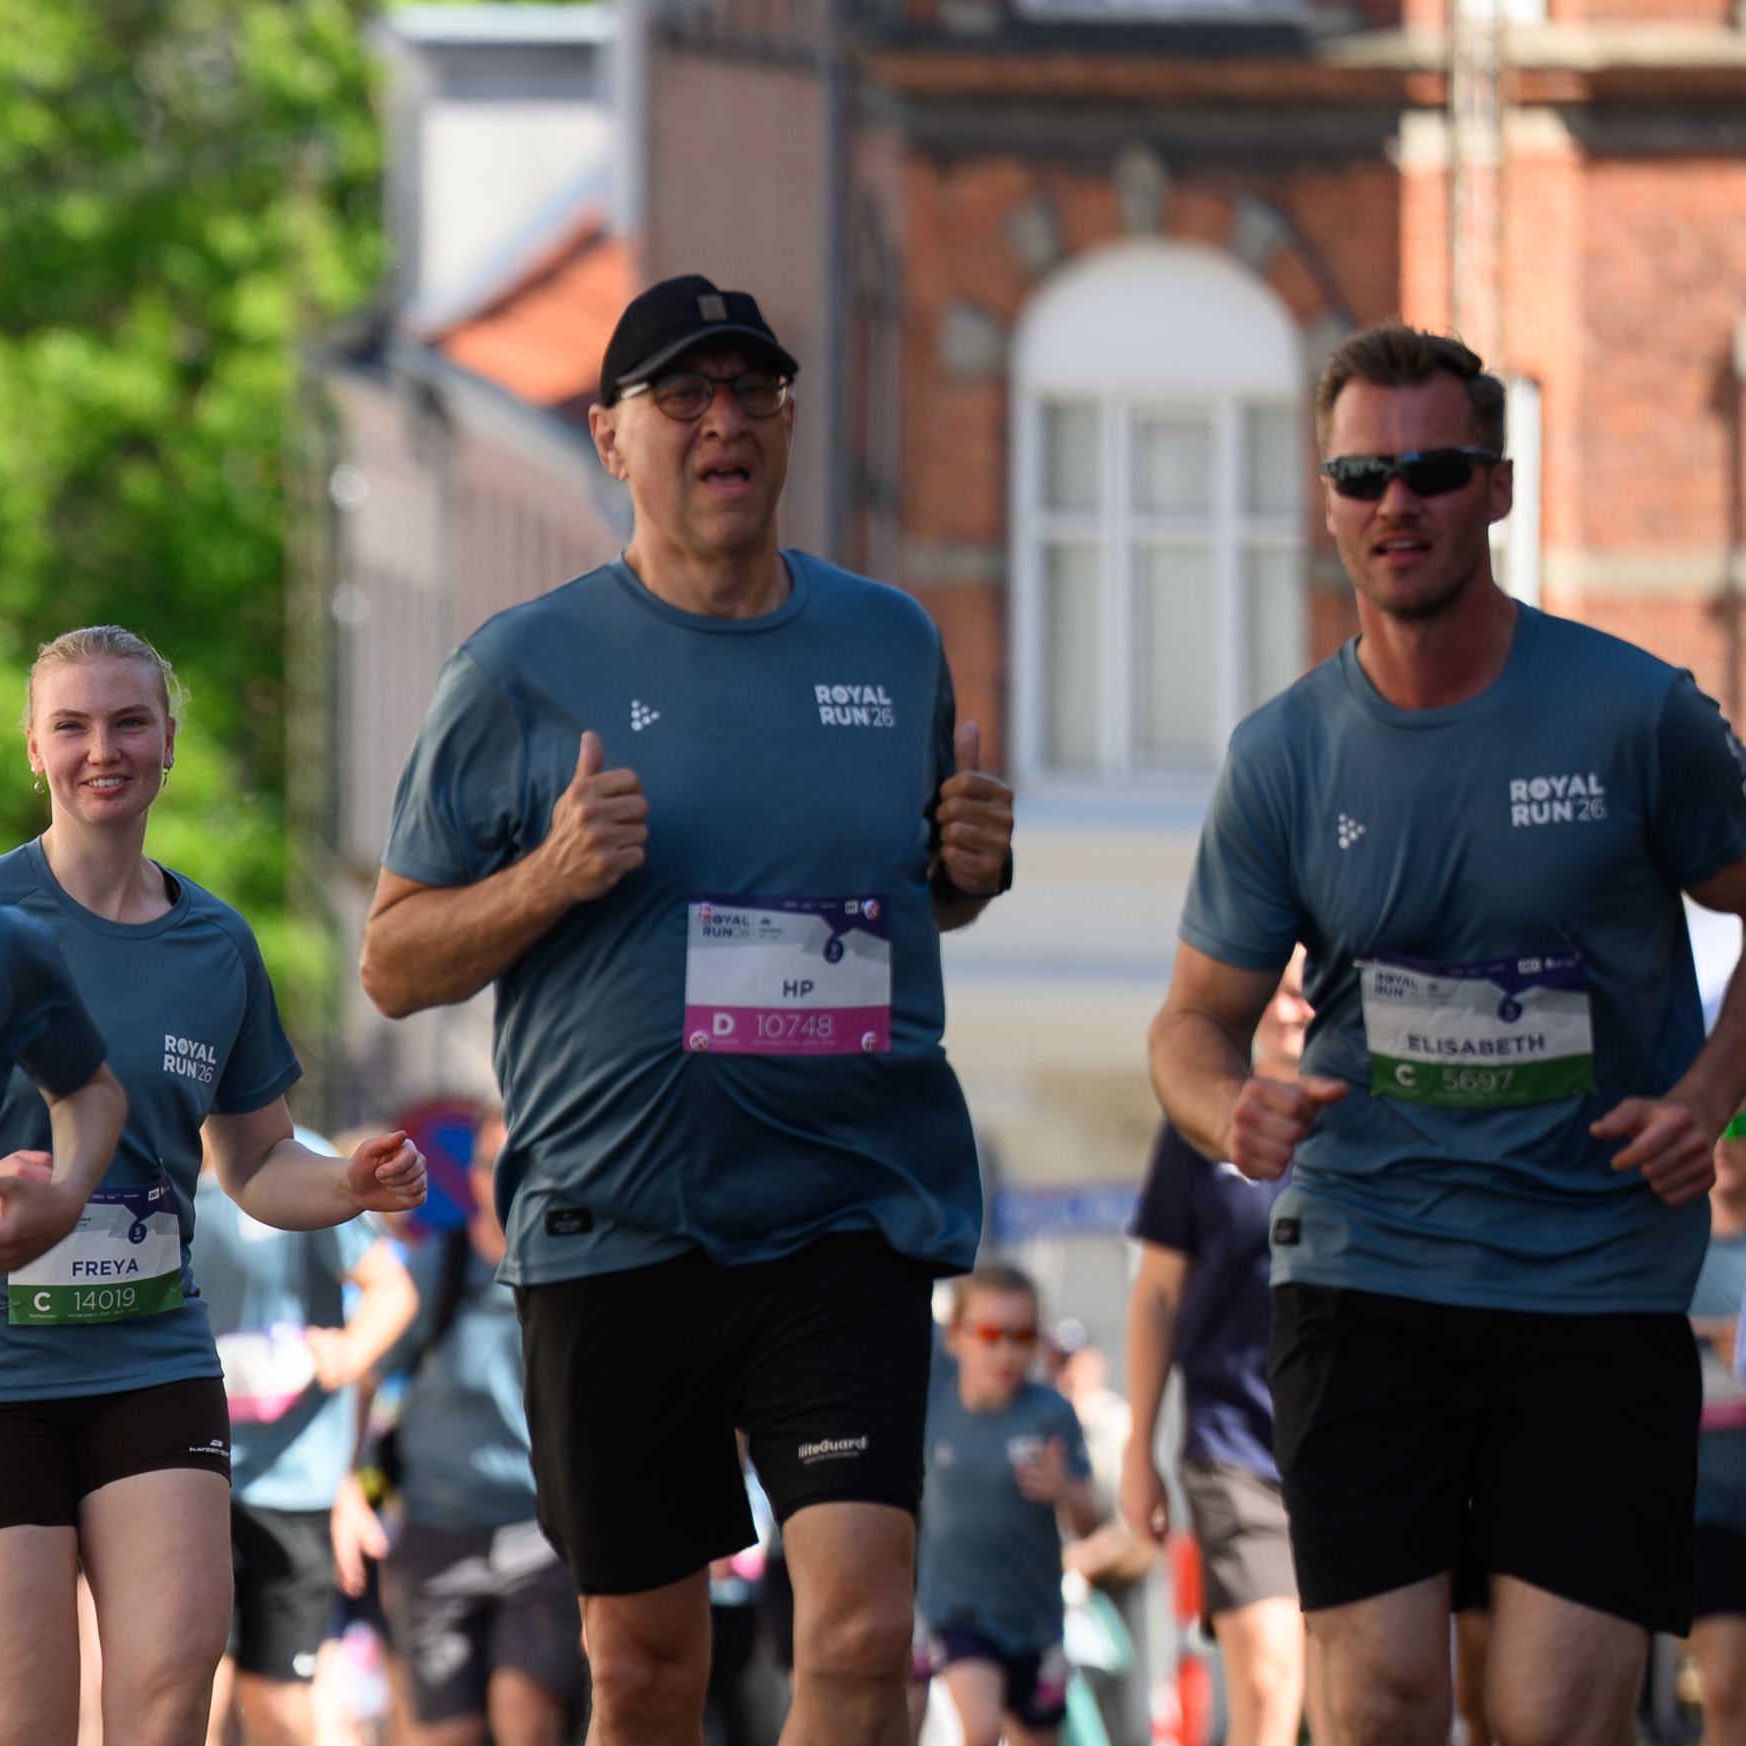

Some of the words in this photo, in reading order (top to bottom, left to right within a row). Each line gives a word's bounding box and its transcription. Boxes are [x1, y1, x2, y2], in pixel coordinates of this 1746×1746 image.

[814, 684, 893, 705] ROYAL
[1510, 773, 1604, 802] ROYAL
[782, 980, 814, 998] HP
[713, 1012, 735, 1036] D
[755, 1014, 835, 1038] 10748
[164, 1034, 216, 1064] ROYAL
[1407, 1034, 1544, 1056] ELISABETH
[163, 1054, 214, 1083] RUN'26
[1395, 1063, 1415, 1087] C
[1442, 1068, 1515, 1092] 5697
[135, 1227, 141, 1235] 5
[72, 1258, 139, 1277] FREYA
[34, 1292, 51, 1311] C
[73, 1287, 136, 1311] 14019
